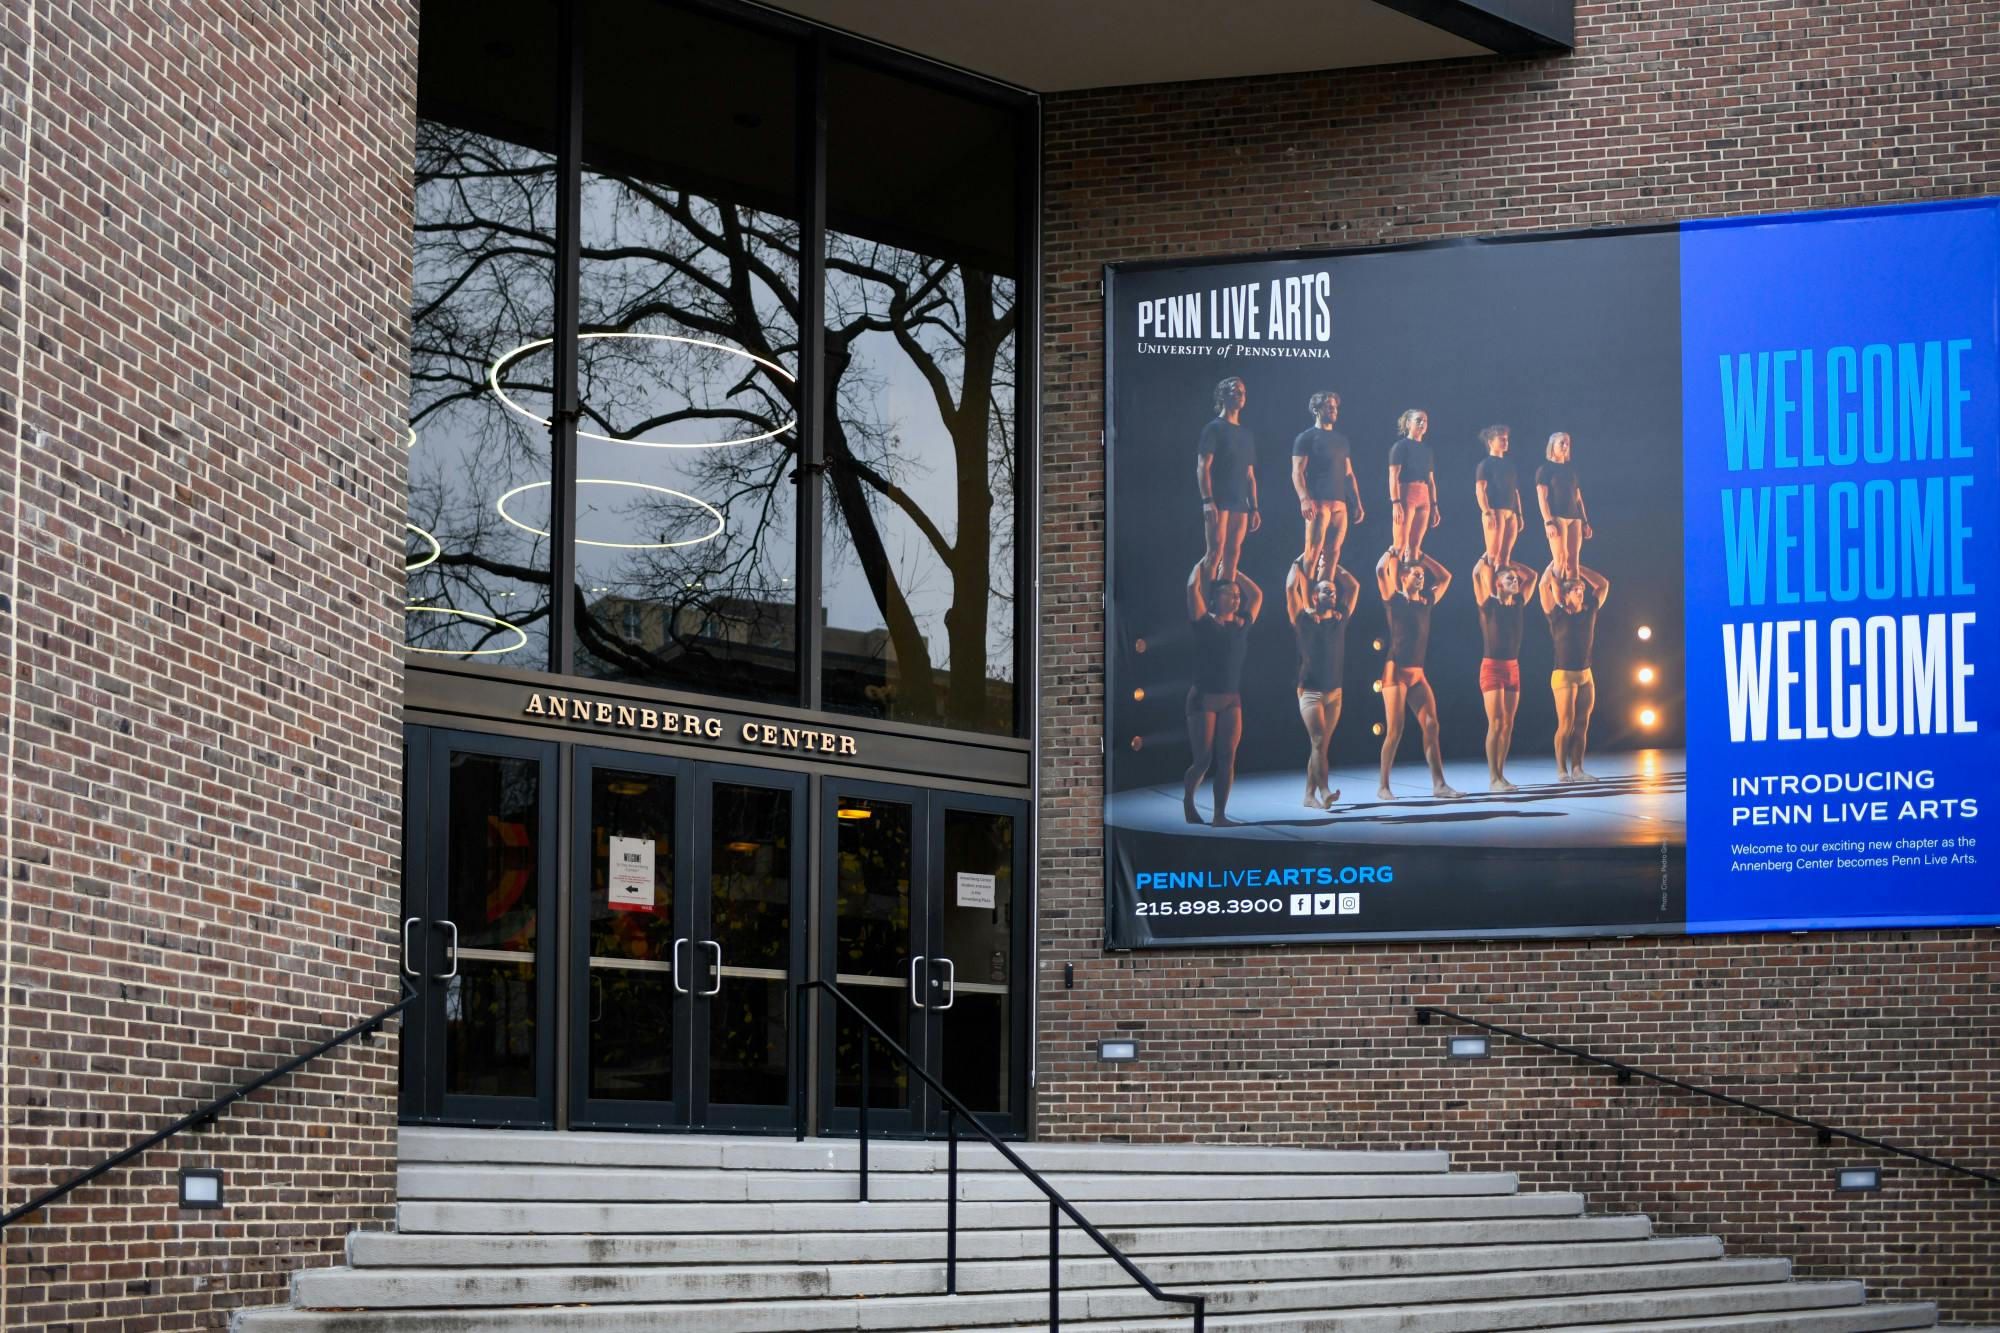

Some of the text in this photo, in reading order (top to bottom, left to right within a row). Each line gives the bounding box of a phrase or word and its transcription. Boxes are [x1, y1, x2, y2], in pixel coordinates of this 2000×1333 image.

[1138, 271, 1331, 342] PENN LIVE ARTS
[1216, 343, 1233, 359] of
[1719, 338, 1974, 471] WELCOME
[1721, 475, 1976, 607] WELCOME
[1722, 611, 1978, 743] WELCOME
[525, 693, 857, 755] ANNENBERG CENTER
[1731, 769, 1935, 797] INTRODUCING
[1731, 798, 1979, 827] PENN LIVE ARTS
[1731, 835, 1976, 856] Welcome to our exciting new chapter as the
[1731, 852, 1977, 873] Annenberg Center becomes Penn Live Arts.
[1135, 865, 1393, 890] PENNLIVEARTS.ORG
[1134, 898, 1283, 916] 215.898.3900
